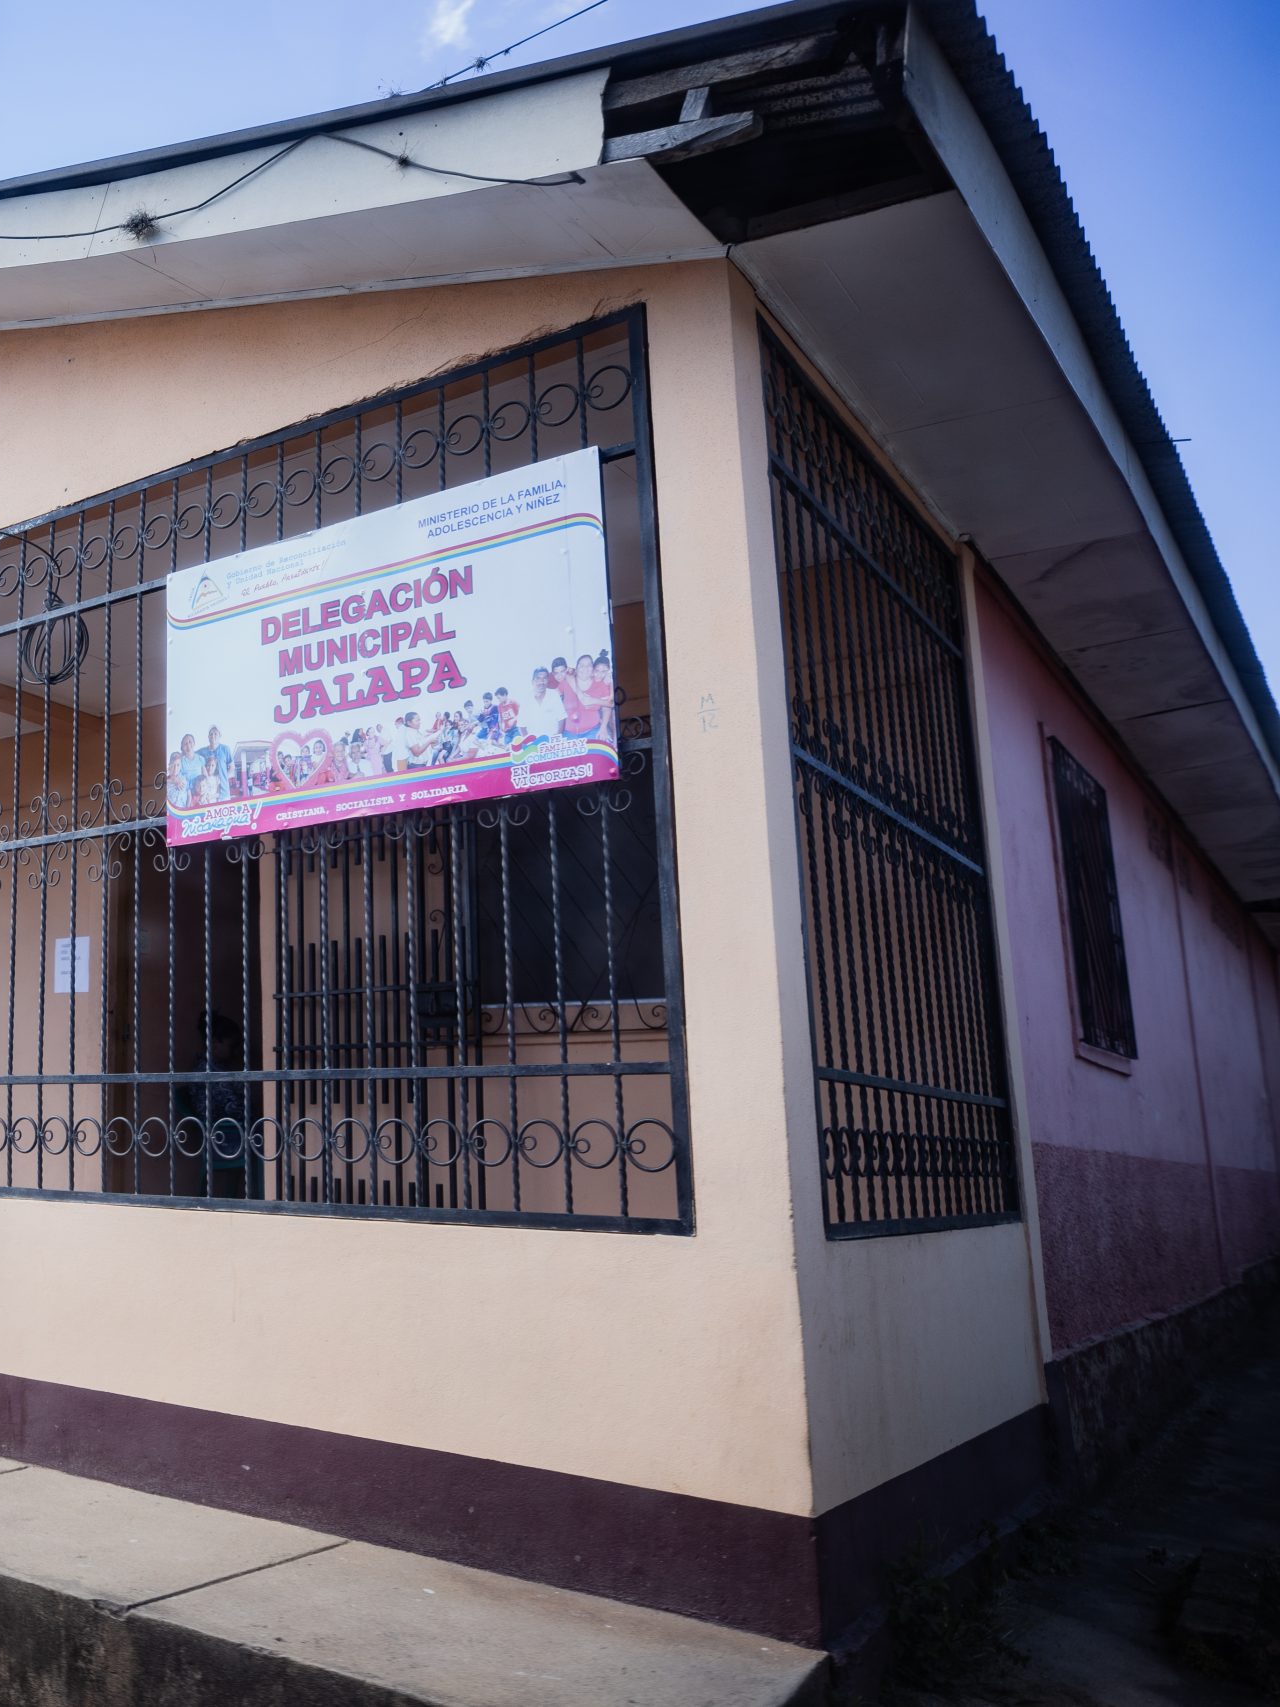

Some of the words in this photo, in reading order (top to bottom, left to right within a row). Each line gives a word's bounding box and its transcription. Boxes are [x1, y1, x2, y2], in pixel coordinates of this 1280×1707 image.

[417, 503, 480, 529] MINISTERIO
[482, 498, 498, 511] DE
[500, 493, 515, 505] LA
[517, 479, 567, 500] FAMILIA,
[427, 506, 514, 539] ADOLESCENCIA
[515, 503, 524, 514] Y
[526, 492, 562, 511] NIÑEZ
[261, 564, 473, 646] DELEGACIÓN
[278, 612, 456, 678] MUNICIPAL
[274, 650, 467, 724] JALAPA
[513, 766, 529, 778] EN
[513, 764, 592, 787] VICTORIAS!
[205, 805, 237, 821] AMOR
[241, 802, 252, 814] A
[275, 805, 330, 822] CRISTIANA,
[335, 795, 395, 813] SOCIALISTA
[399, 793, 406, 803] Y
[410, 783, 469, 800] SOLIDARIA
